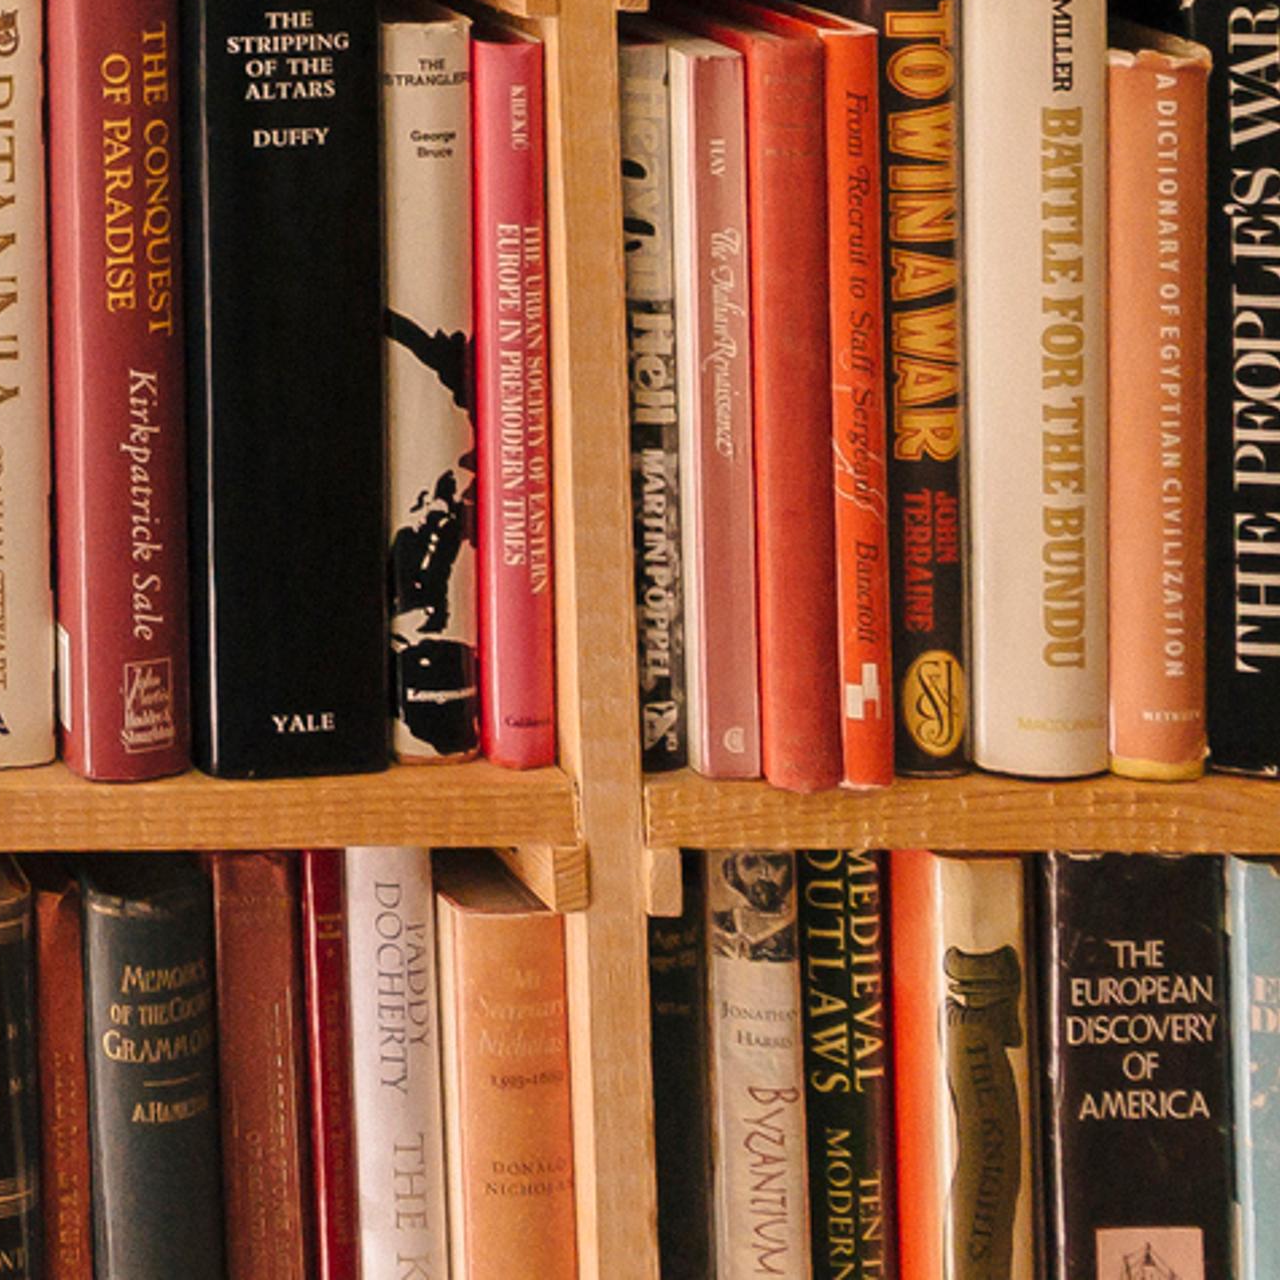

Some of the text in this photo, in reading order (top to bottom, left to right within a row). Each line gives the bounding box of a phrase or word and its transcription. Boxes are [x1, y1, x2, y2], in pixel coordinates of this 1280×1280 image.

[265, 12, 315, 29] THE
[227, 33, 349, 52] STRIPPING
[245, 57, 334, 76] OF THE
[245, 78, 336, 99] ALTARS
[253, 127, 329, 147] DUFFY
[100, 53, 135, 312] OF PARADISE
[142, 27, 173, 337] THE CONQUEST
[1040, 106, 1084, 284] BATTLE
[886, 1, 961, 462] TO WIN A WAR
[1042, 293, 1084, 388] FOR
[498, 224, 525, 567] EUROPE IN PREMODERN TIMES
[1042, 397, 1085, 495] THE
[120, 368, 163, 640] Kirkpatrick Sale
[1042, 505, 1086, 669] BUNDU
[272, 713, 335, 733] YALE
[1109, 940, 1164, 968] THE
[373, 882, 408, 1096] DOCHERTY
[1071, 979, 1212, 1007] EUROPEAN
[1068, 1015, 1216, 1044] DISCOVERY
[1123, 1052, 1159, 1080] OF
[1079, 1092, 1209, 1120] AMERICA
